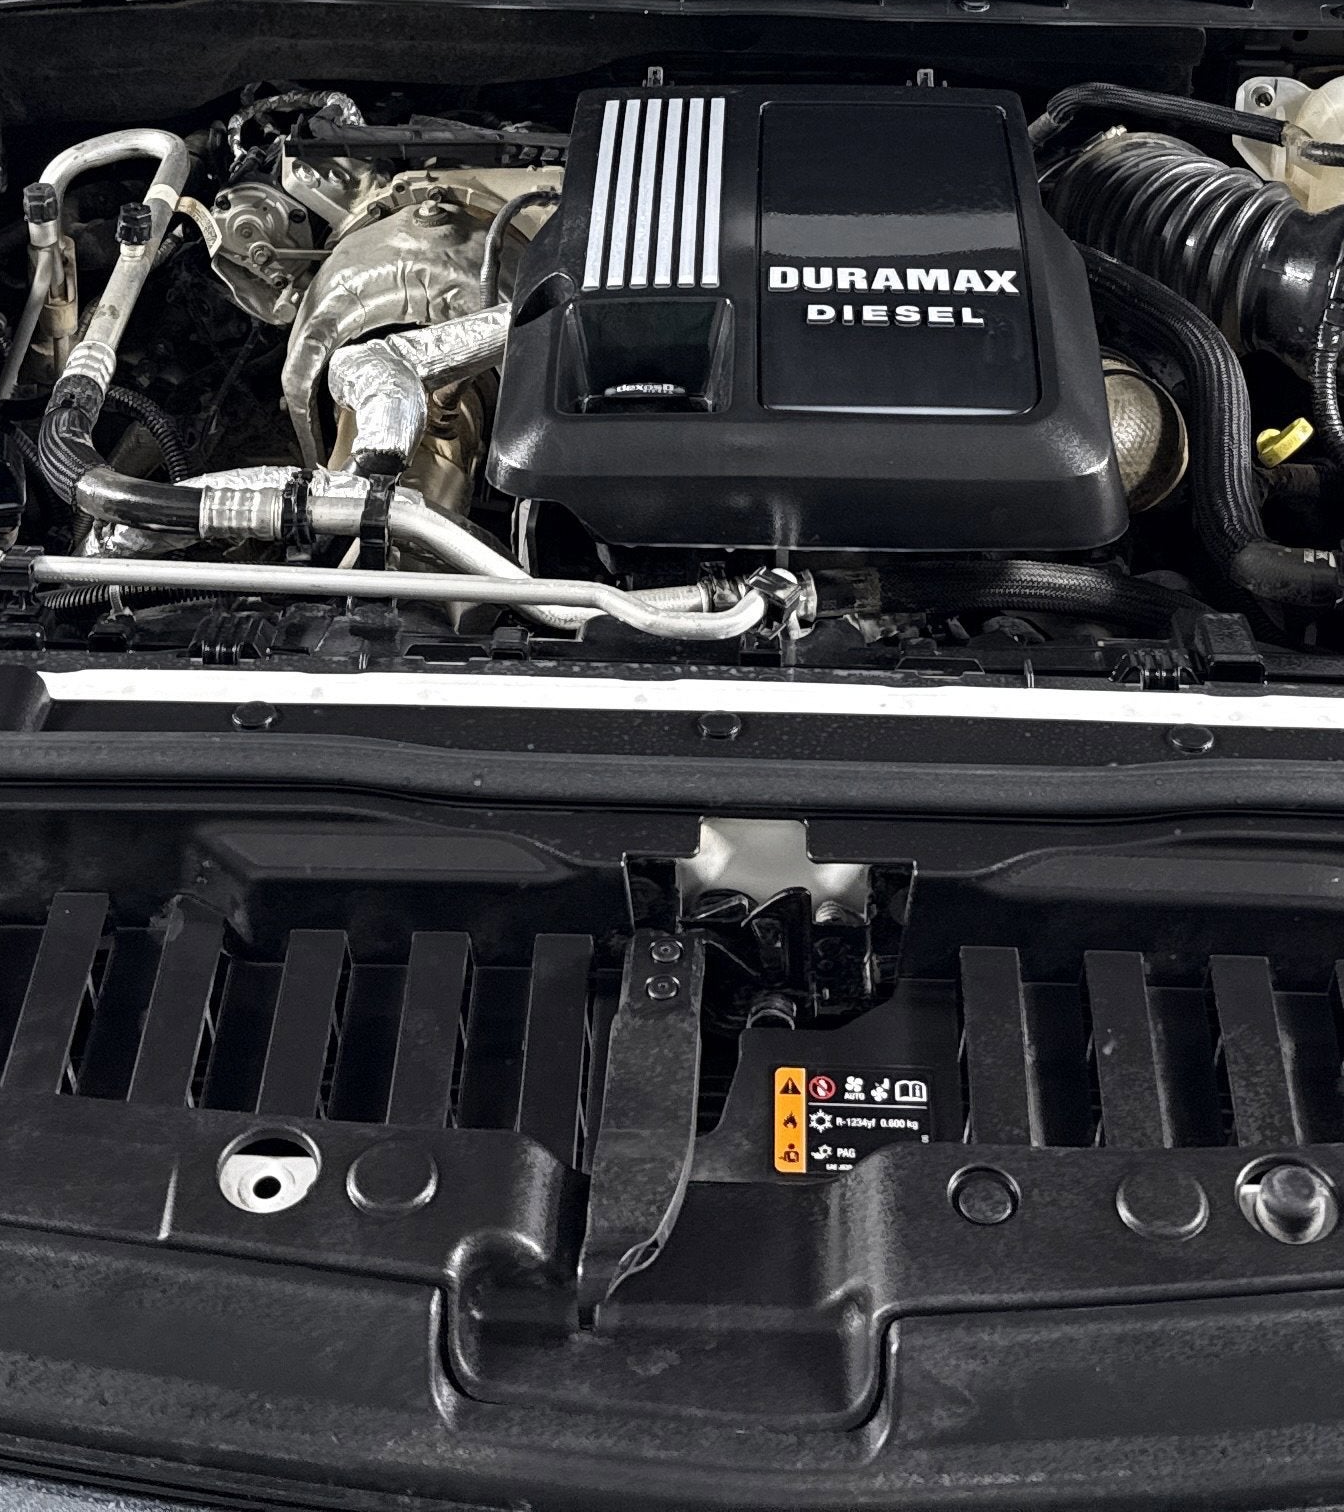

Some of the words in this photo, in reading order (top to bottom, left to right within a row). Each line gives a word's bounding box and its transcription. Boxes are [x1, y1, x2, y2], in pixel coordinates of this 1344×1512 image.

[768, 266, 1020, 296] DURAMAX
[806, 304, 985, 327] DIESEL
[843, 1091, 865, 1101] AUTO
[835, 1116, 876, 1129] R-1234yf
[879, 1117, 906, 1129] 0.600
[906, 1118, 919, 1131] kg
[836, 1147, 856, 1159] PAG
